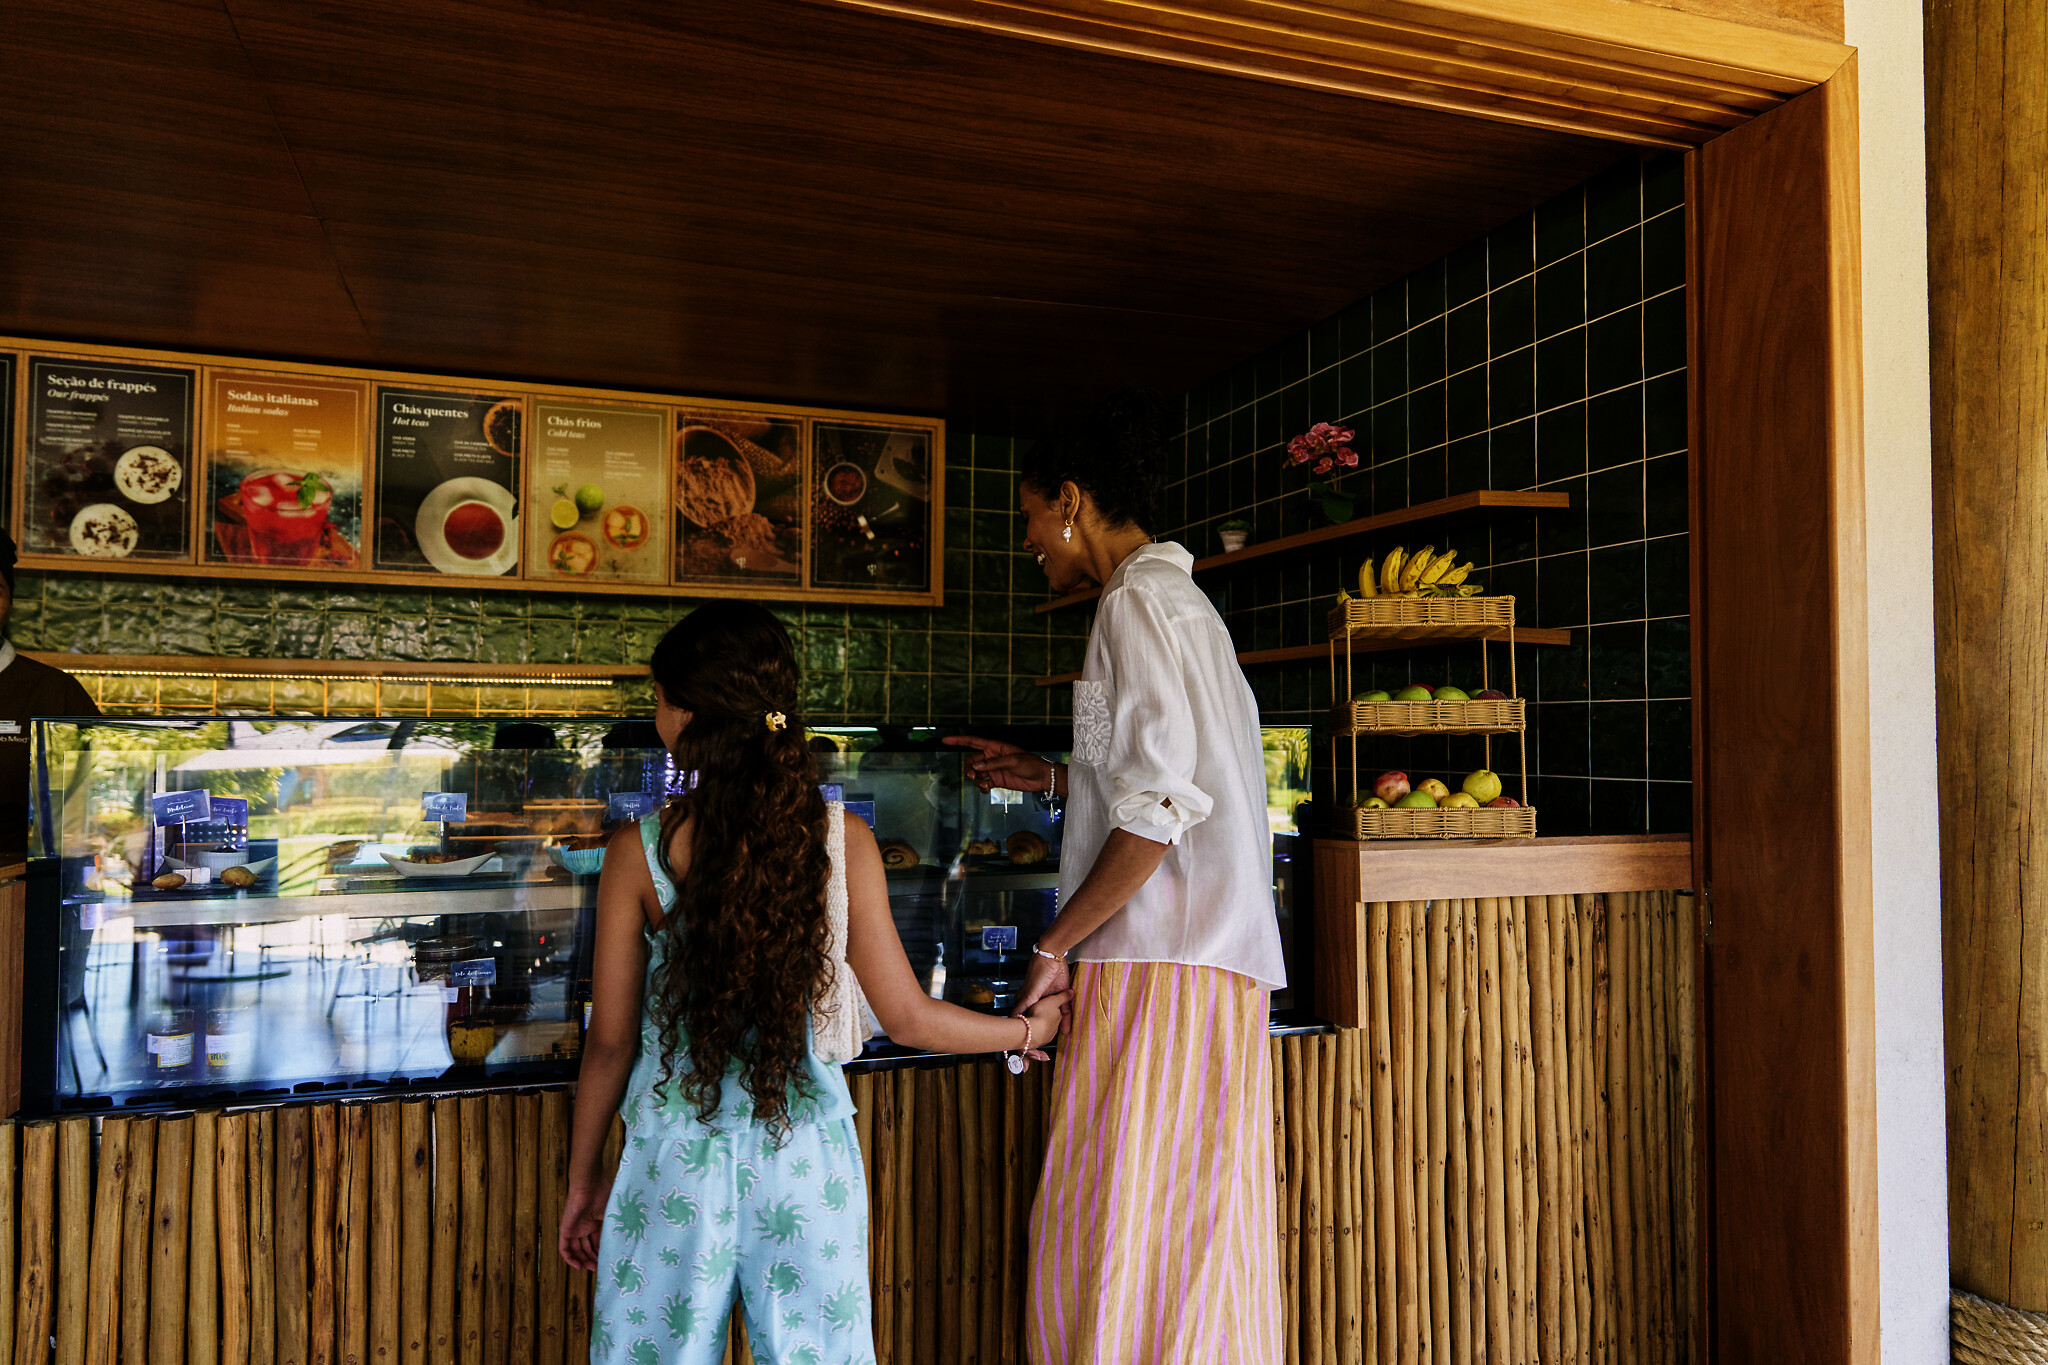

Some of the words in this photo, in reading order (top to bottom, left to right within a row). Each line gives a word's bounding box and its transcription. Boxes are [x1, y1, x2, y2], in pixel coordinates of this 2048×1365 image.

[47, 374, 87, 388] Seção
[88, 378, 105, 388] de
[107, 379, 157, 394] frappés
[47, 389, 69, 399] Our
[69, 390, 110, 402] frappés
[227, 390, 264, 402] Sodas
[266, 393, 319, 406] italianas
[227, 404, 260, 414] Italian
[262, 407, 289, 416] sodas
[392, 403, 422, 414] Chás
[424, 408, 469, 418] quentes
[392, 417, 410, 426] Hot
[411, 418, 430, 427] teas
[547, 416, 575, 427] Chás
[576, 418, 602, 428] frios
[547, 429, 568, 438] Cold
[568, 430, 586, 438] teas
